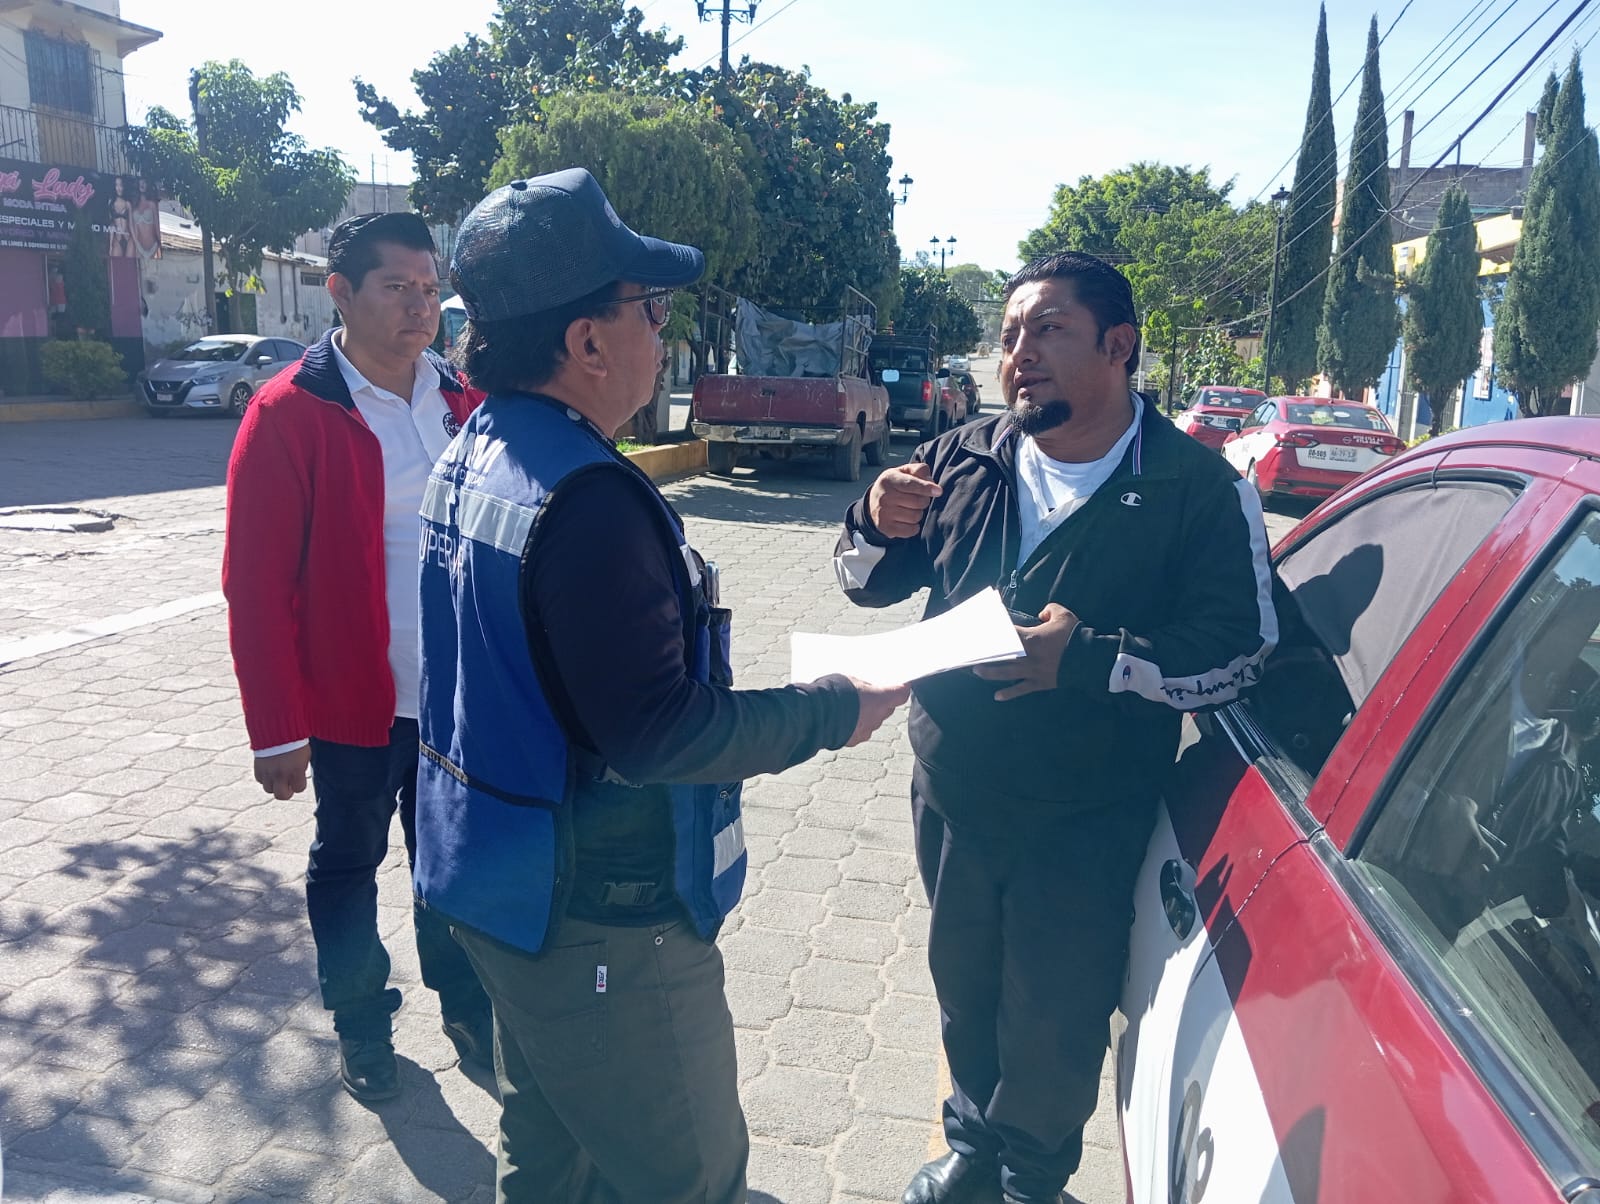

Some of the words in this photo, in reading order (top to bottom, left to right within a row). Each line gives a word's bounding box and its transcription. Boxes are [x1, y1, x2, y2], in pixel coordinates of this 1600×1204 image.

[32, 168, 95, 208] Lady
[3, 197, 33, 210] MODA
[58, 220, 64, 229] Y
